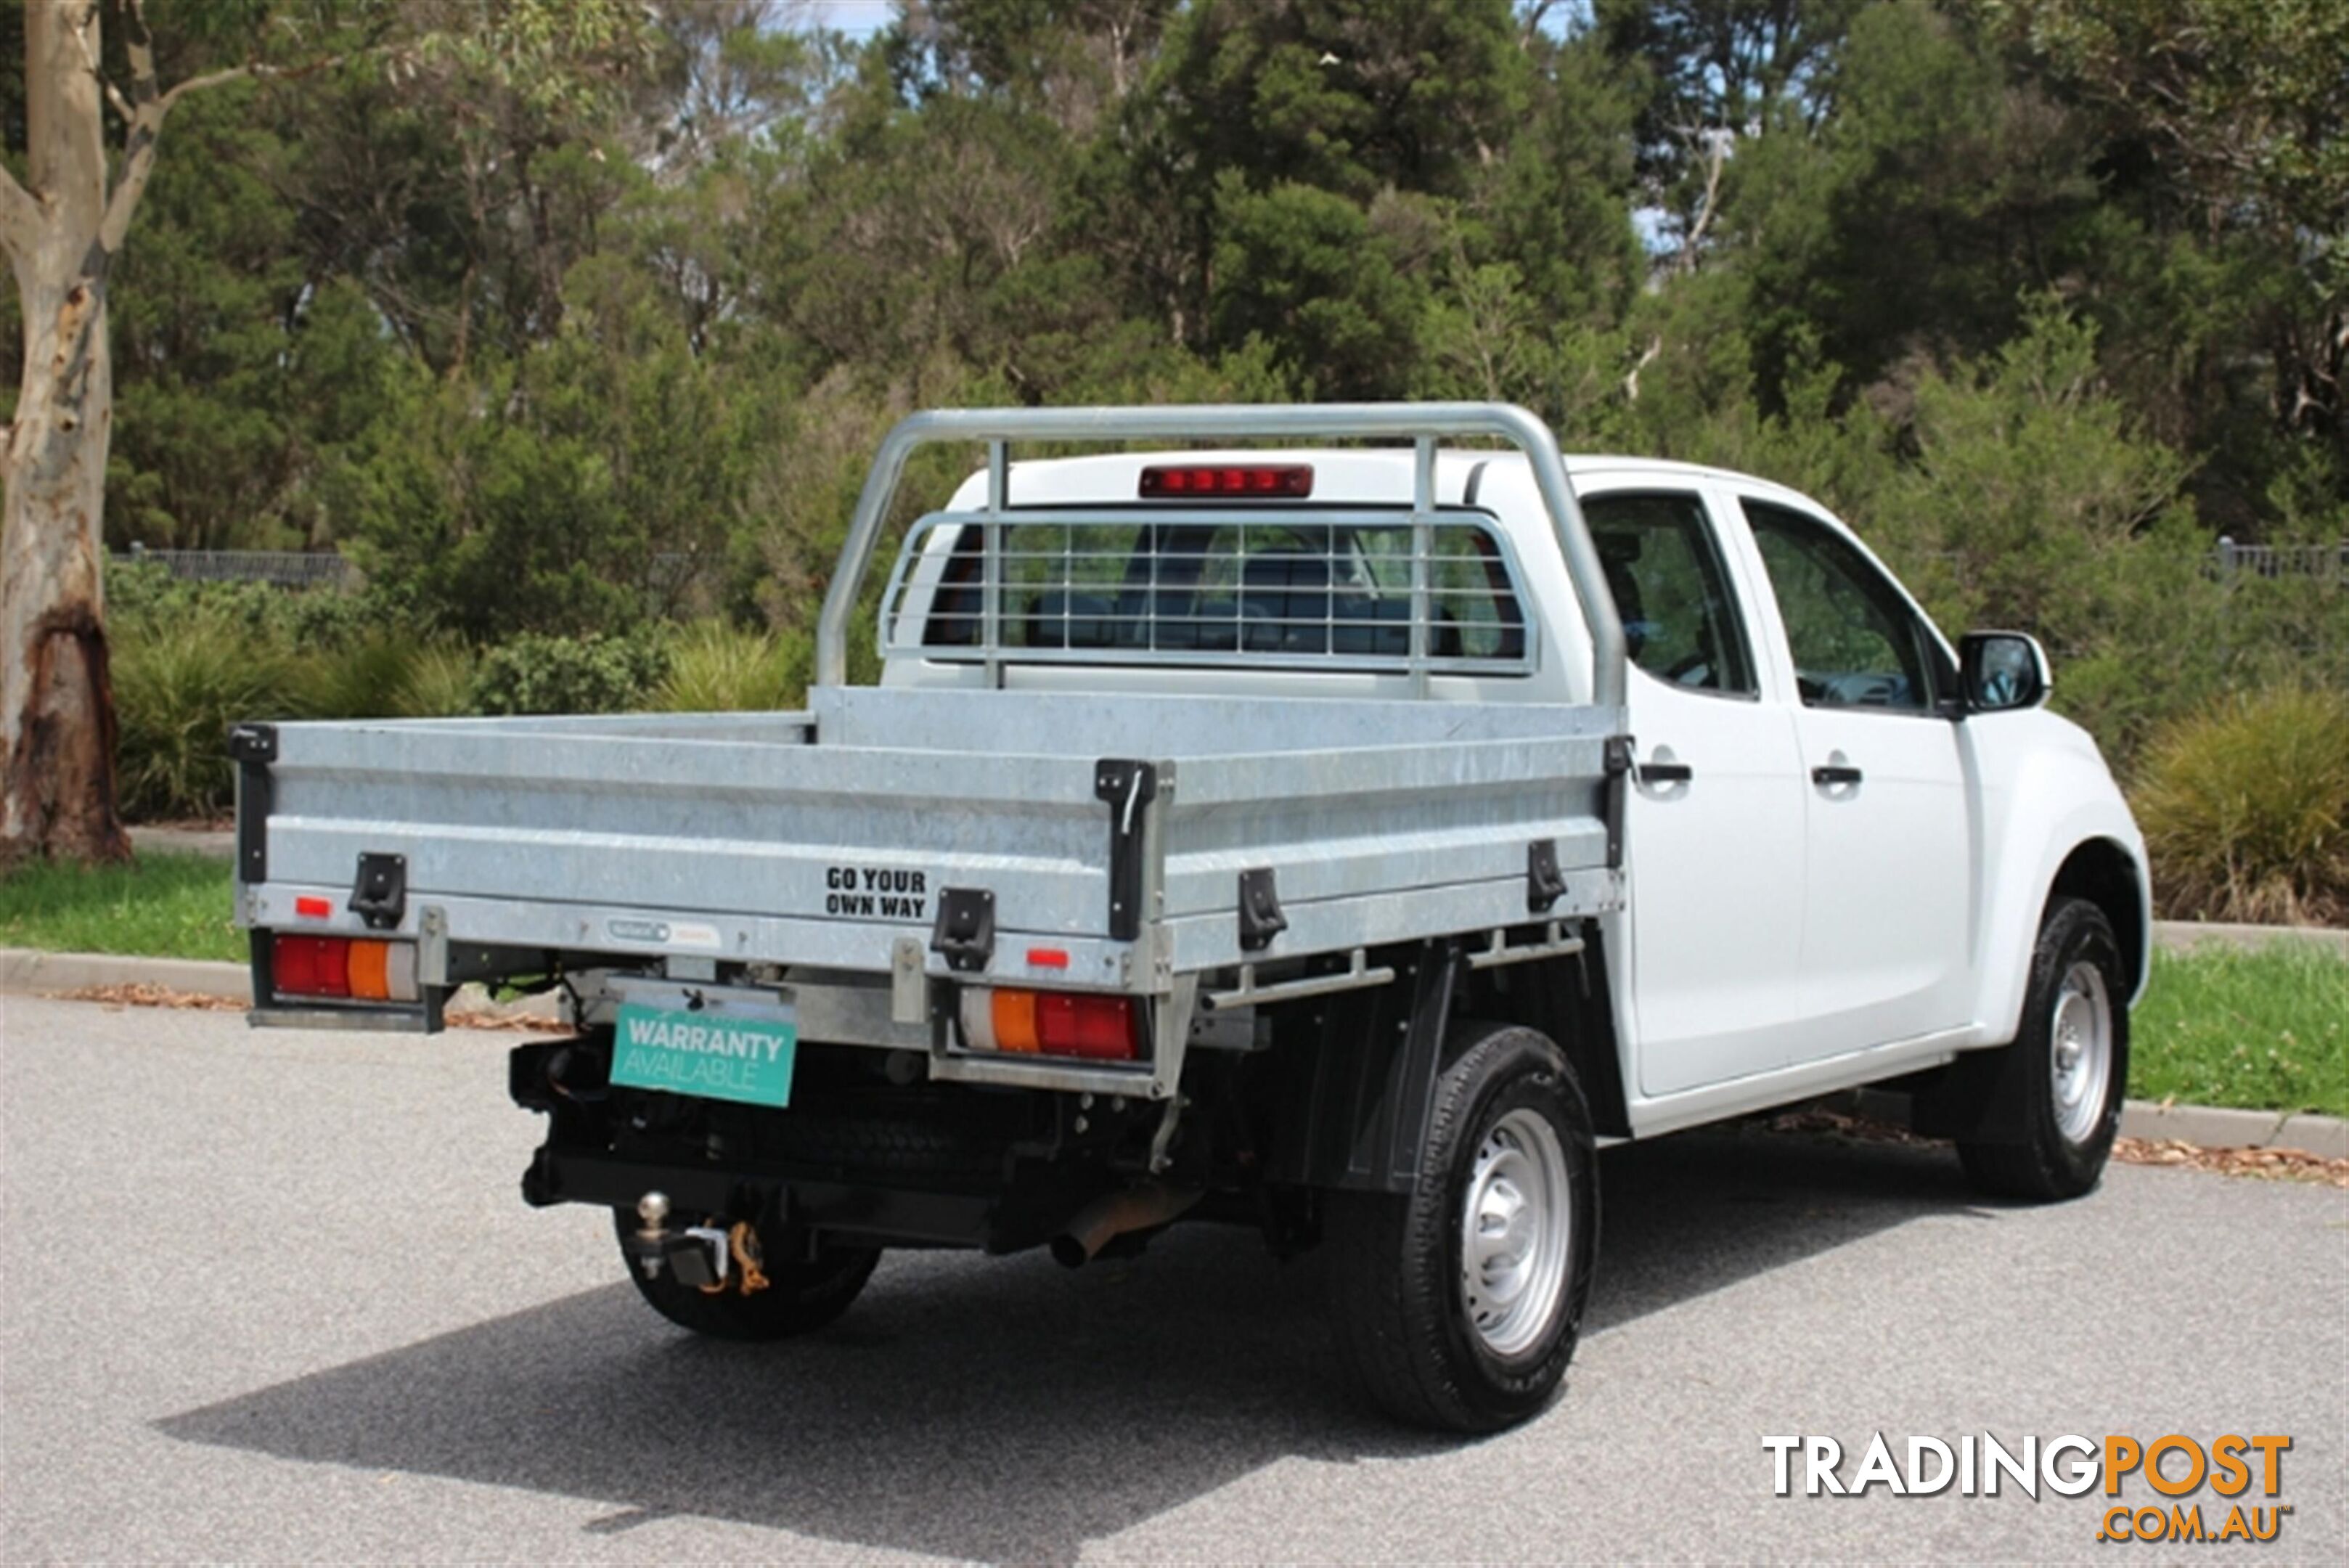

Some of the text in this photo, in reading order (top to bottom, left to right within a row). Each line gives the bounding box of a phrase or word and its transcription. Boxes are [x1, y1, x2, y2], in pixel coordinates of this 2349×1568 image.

[828, 867, 925, 893] GO YOUR
[827, 894, 925, 918] OWN WAY
[628, 1018, 784, 1063] WARRANTY
[623, 1049, 759, 1091] AVAILABLE
